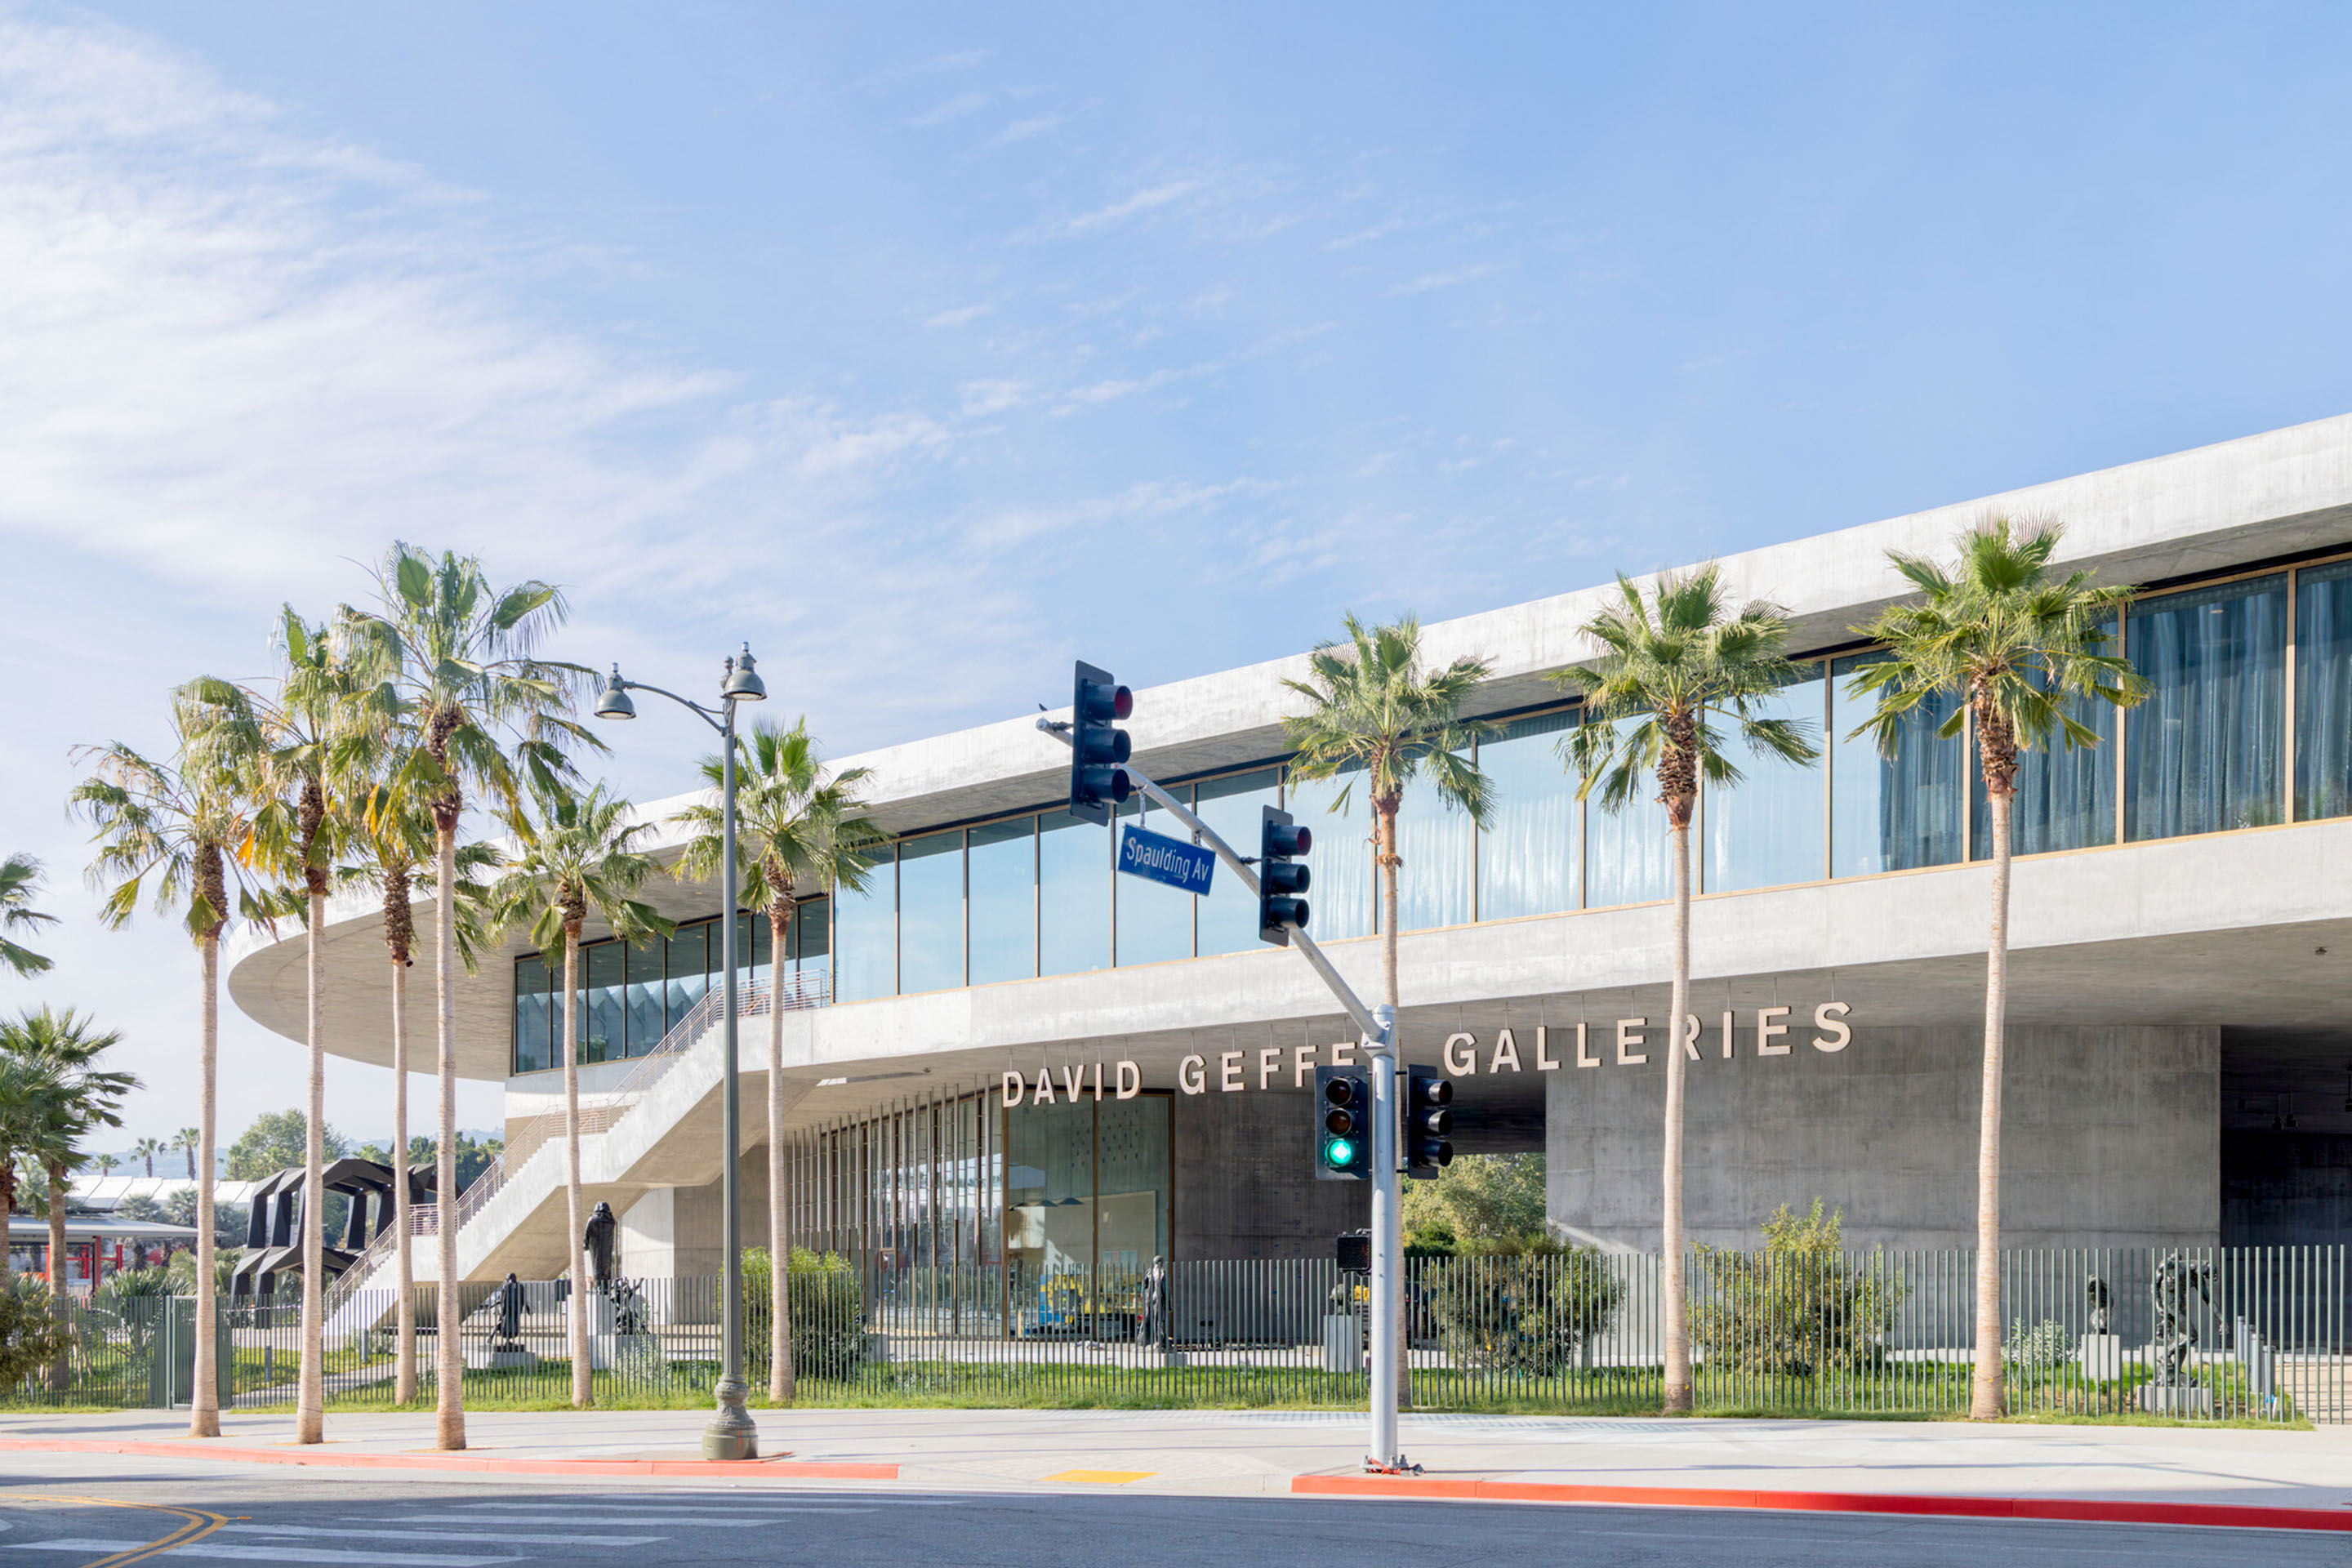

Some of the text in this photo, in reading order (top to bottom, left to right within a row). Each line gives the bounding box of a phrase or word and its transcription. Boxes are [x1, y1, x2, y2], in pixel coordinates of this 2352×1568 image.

[1126, 837, 1209, 884] Spaulding Av
[1002, 1000, 1852, 1108] DAVID GEFFE GALLERIES
